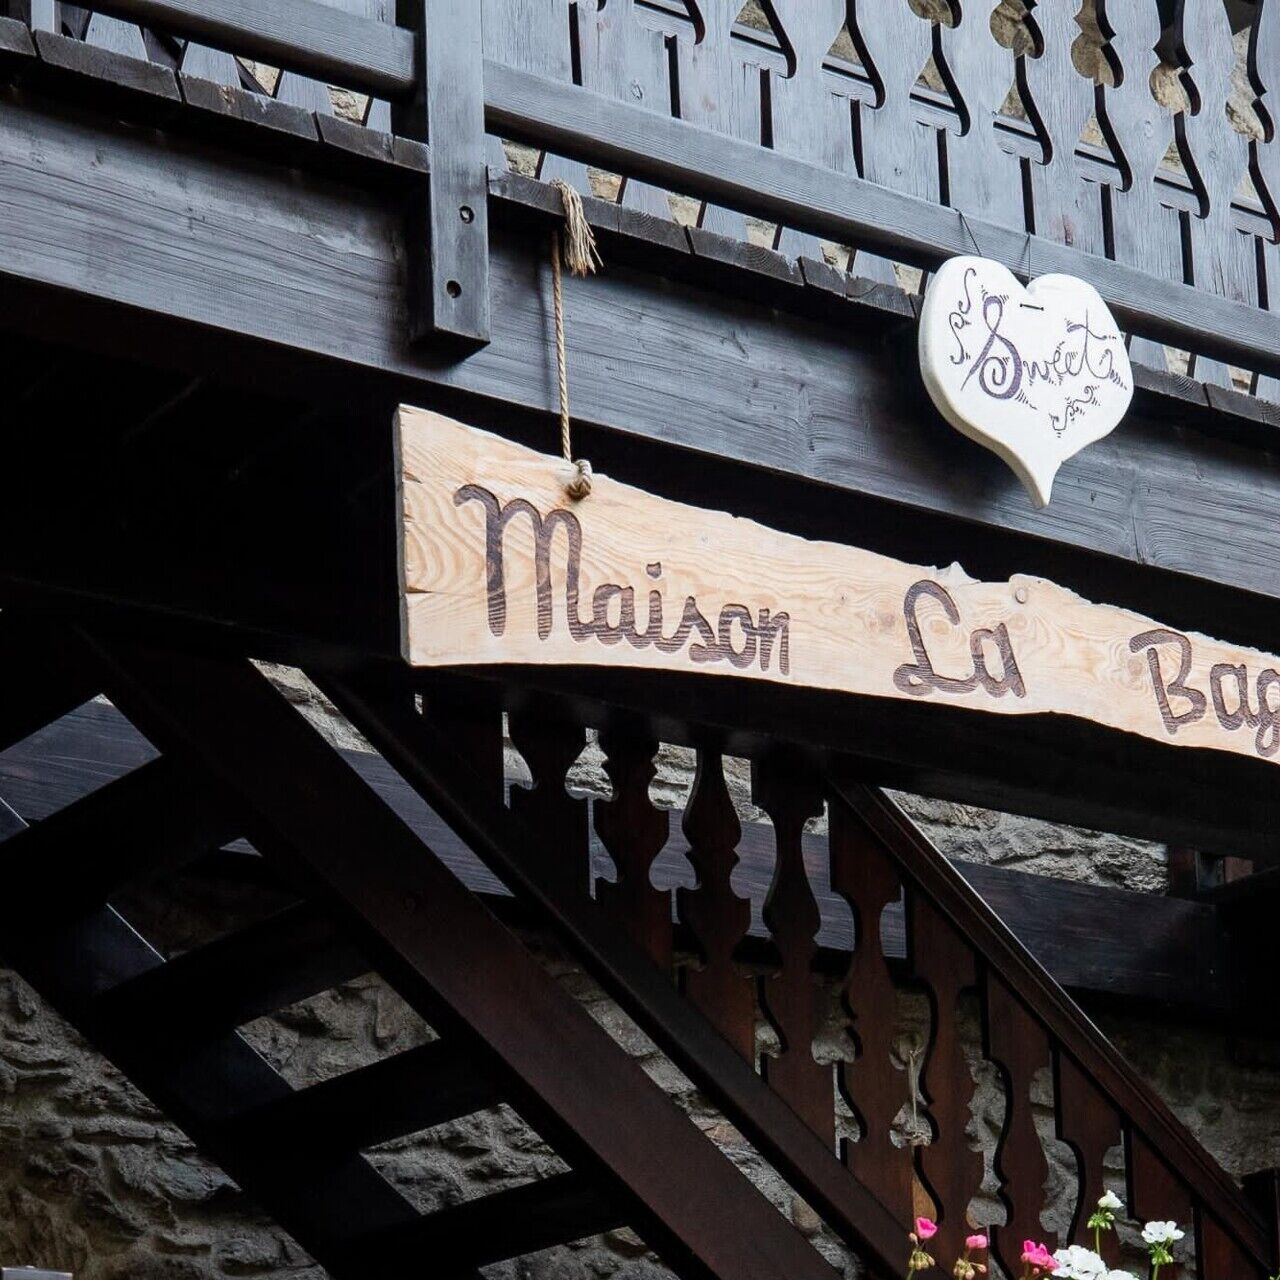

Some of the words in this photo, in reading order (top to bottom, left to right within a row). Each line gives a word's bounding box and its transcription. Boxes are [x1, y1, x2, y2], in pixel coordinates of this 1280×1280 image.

[960, 295, 1114, 401] Sweet
[452, 482, 790, 677] Maison
[894, 578, 1024, 698] La
